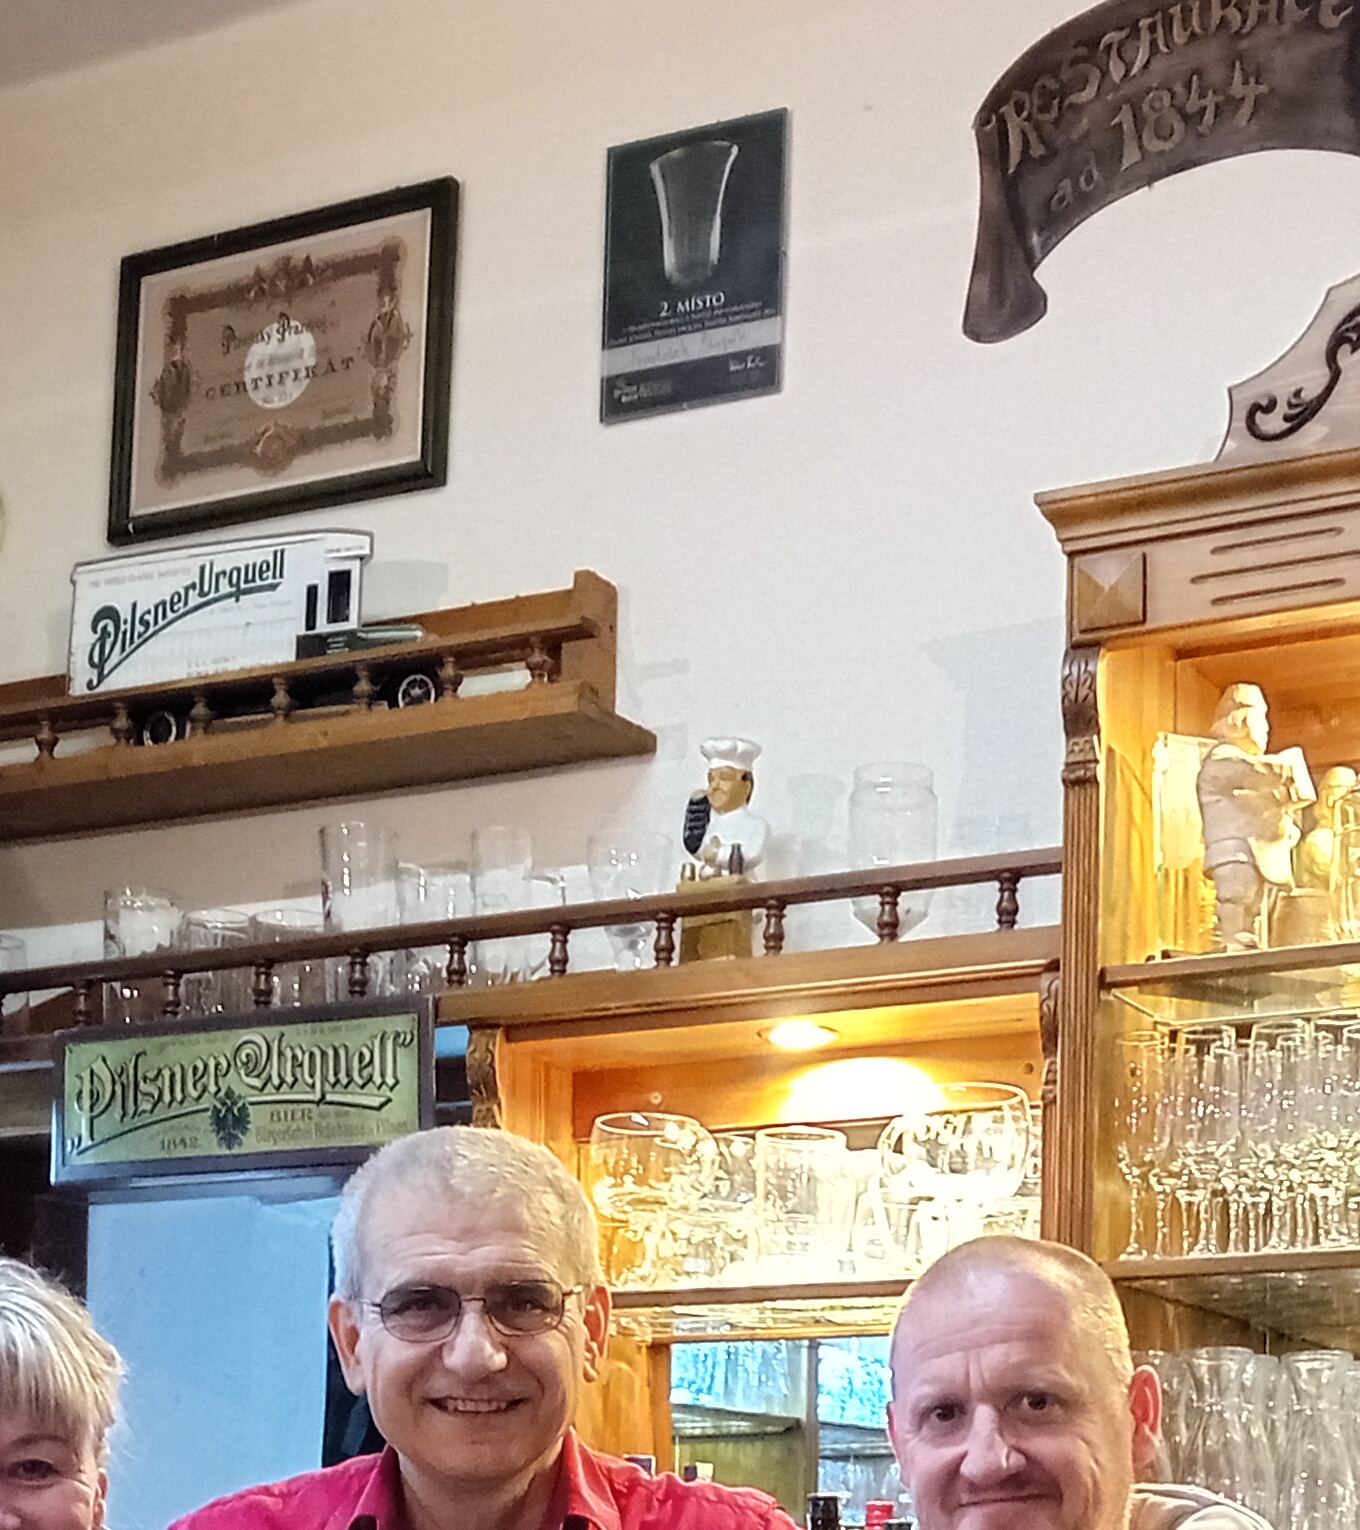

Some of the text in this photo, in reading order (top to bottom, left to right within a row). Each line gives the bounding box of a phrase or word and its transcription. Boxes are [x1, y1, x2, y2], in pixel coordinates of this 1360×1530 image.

[1110, 60, 1270, 171] 1844
[676, 291, 726, 314] MÍSTO
[269, 1107, 314, 1124] BIER
